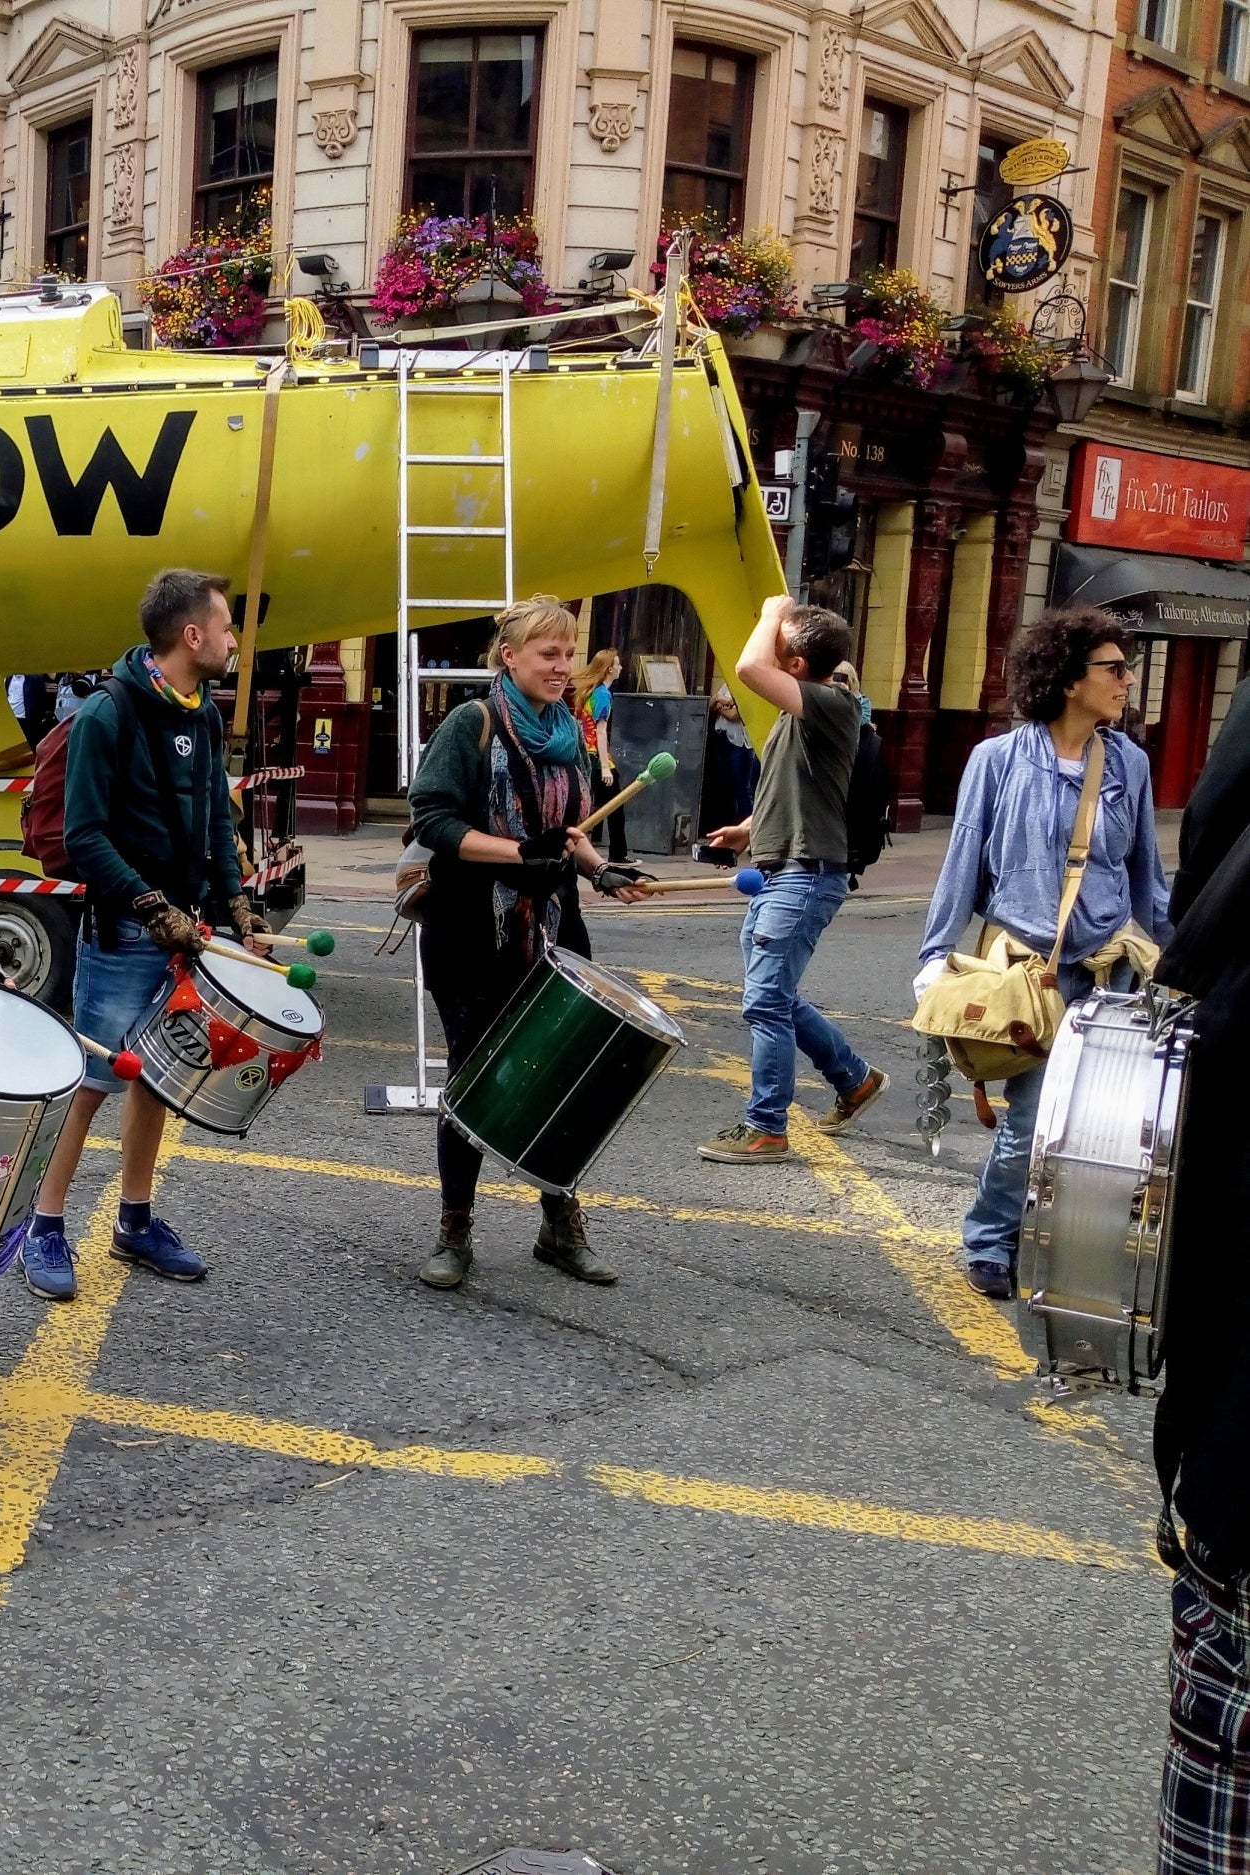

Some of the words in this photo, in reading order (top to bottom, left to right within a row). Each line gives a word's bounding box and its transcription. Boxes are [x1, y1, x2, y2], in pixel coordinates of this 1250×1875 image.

[1026, 271, 1048, 288] ARMS
[841, 440, 860, 459] No.
[865, 445, 885, 461] 138
[1125, 477, 1179, 516] fix2fit
[1182, 487, 1230, 523] Tailors
[1156, 602, 1199, 625] Tailoring
[1200, 606, 1244, 625] Alterations
